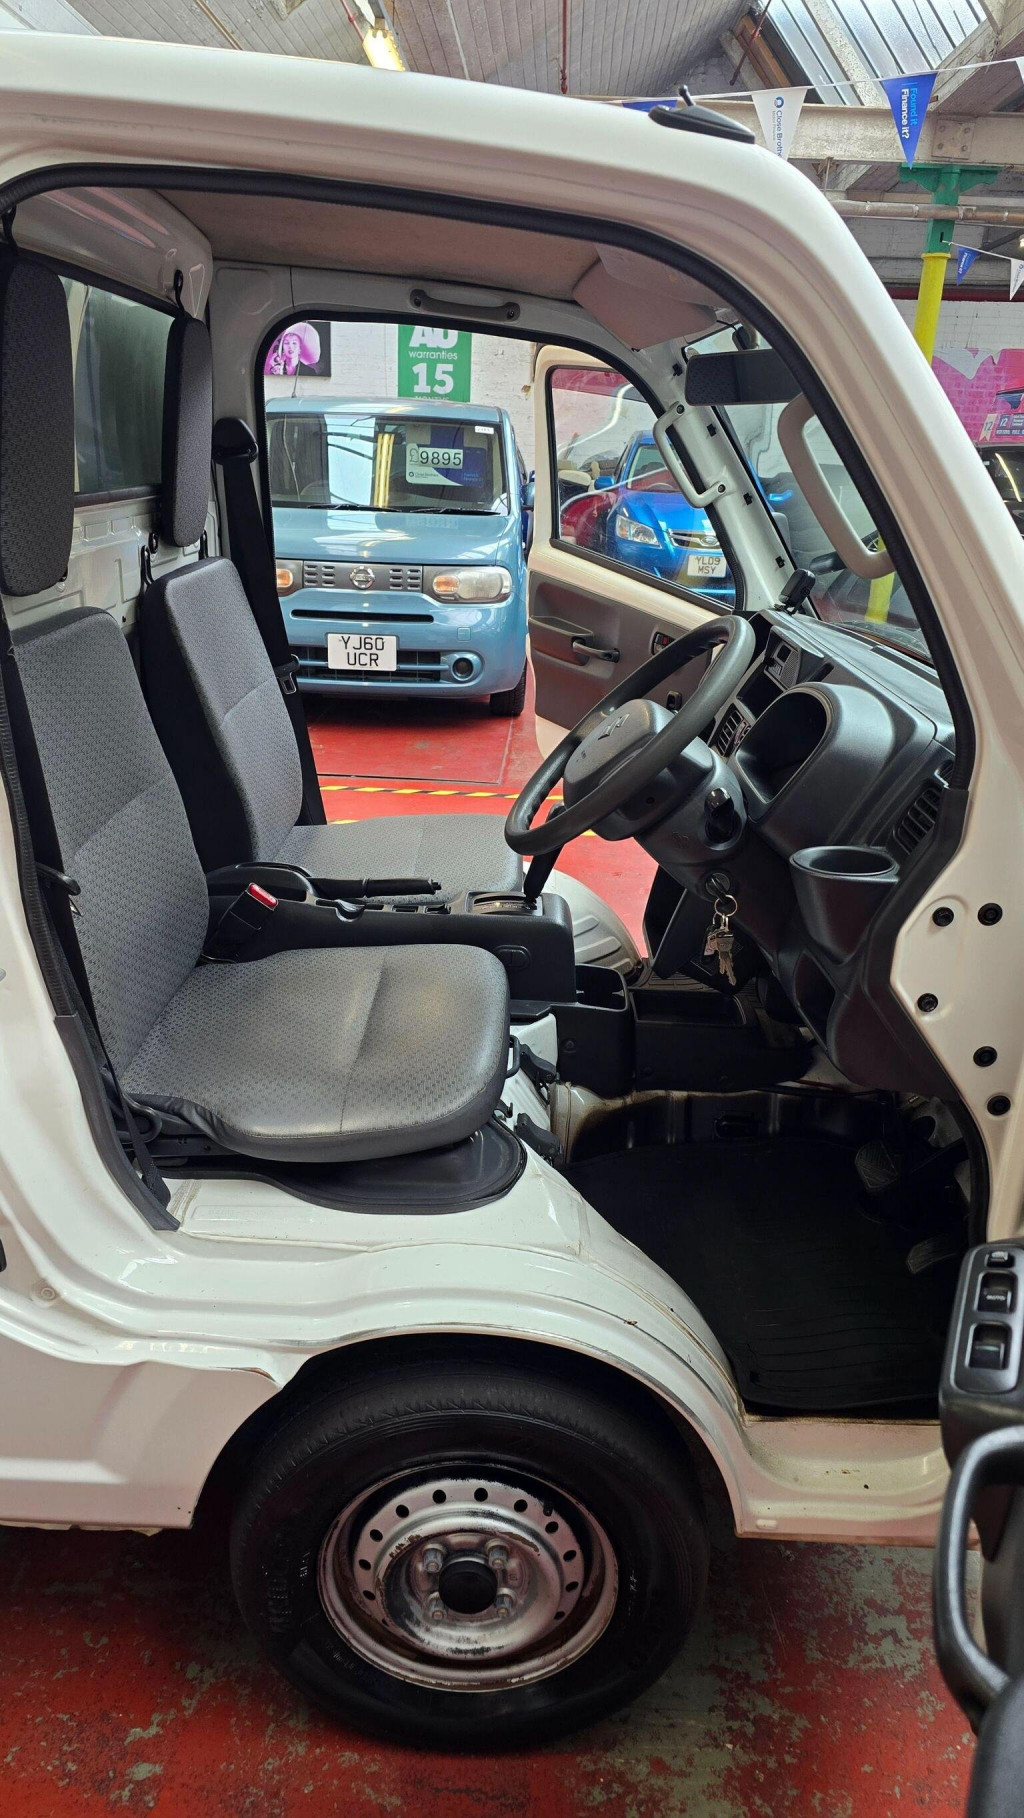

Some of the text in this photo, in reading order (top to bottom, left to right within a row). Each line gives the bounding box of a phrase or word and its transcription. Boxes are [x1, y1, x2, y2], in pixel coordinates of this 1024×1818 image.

[901, 88, 910, 139] Finance it?
[910, 87, 918, 126] Found it
[408, 350, 458, 360] warranties
[412, 362, 454, 395] 15
[697, 565, 716, 575] MSY
[341, 635, 385, 651] YJ60
[347, 652, 379, 667] UCR
